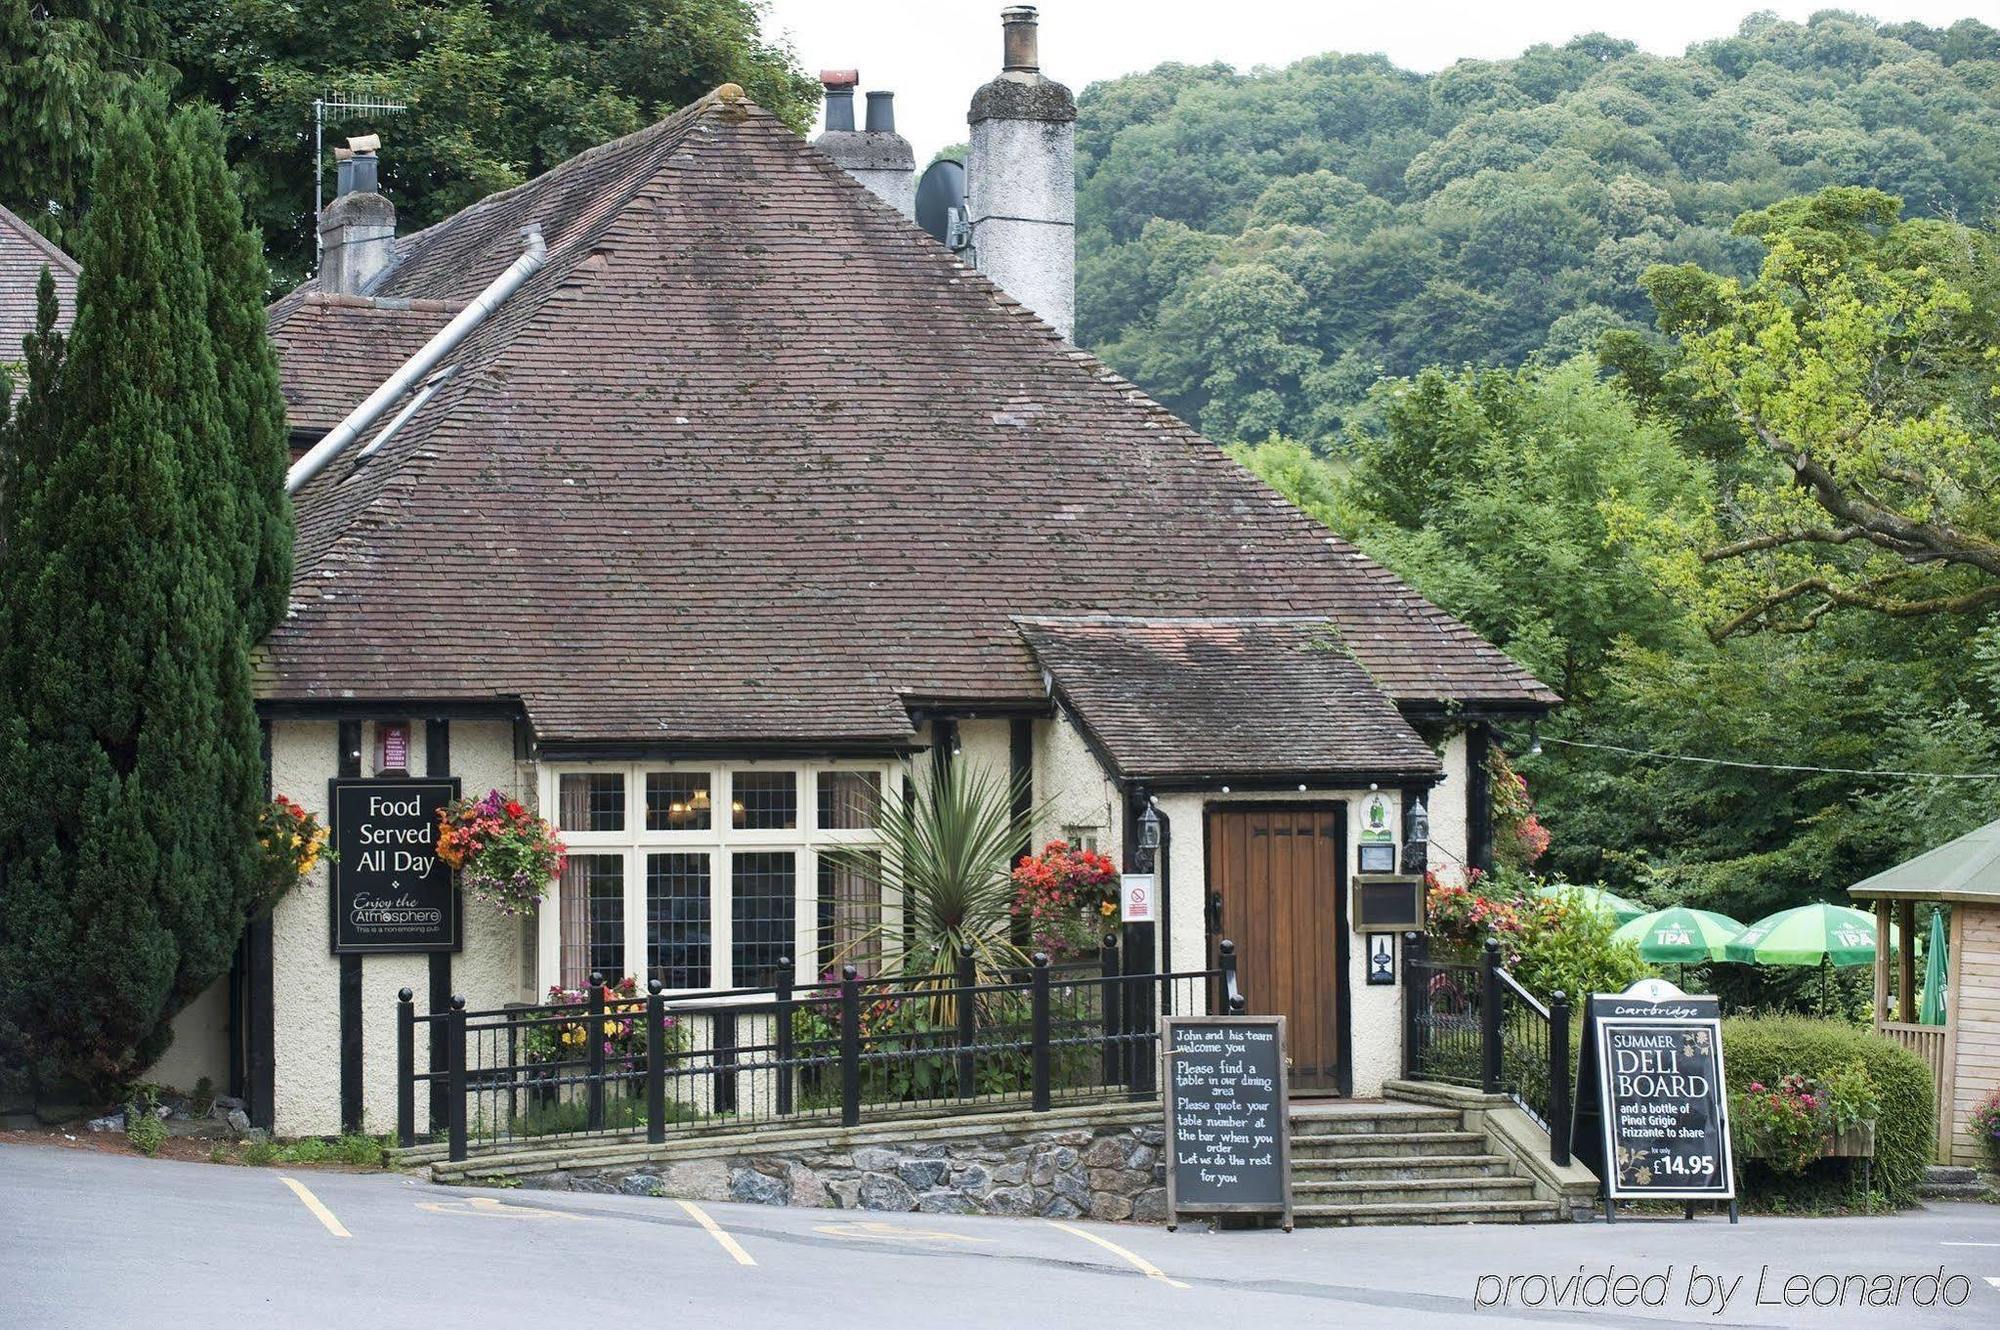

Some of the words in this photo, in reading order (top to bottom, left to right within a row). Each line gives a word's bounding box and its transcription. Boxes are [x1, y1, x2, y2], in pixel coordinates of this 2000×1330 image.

[370, 794, 420, 816] Food
[360, 822, 431, 844] Served
[356, 850, 385, 871] All
[394, 851, 434, 879] Day
[353, 891, 392, 913] Enjoy
[395, 893, 418, 907] the
[356, 911, 439, 923] Atmosphere
[1656, 931, 1691, 945] IPA
[1176, 1030, 1202, 1040] John
[1205, 1030, 1223, 1040] and
[1229, 1030, 1244, 1040] his
[1245, 1030, 1272, 1041] team
[1614, 1035, 1676, 1048] SUMMER
[1177, 1042, 1222, 1053] welcome
[1225, 1044, 1246, 1056] you
[1177, 1061, 1214, 1074] Please
[1219, 1060, 1243, 1073] find
[1249, 1065, 1256, 1073] a
[1616, 1050, 1679, 1074] DELI
[1176, 1075, 1204, 1086] table
[1209, 1077, 1218, 1085] in
[1241, 1074, 1272, 1091] dining
[1618, 1075, 1709, 1097] BOARD
[1178, 1097, 1210, 1110] Please
[1214, 1100, 1242, 1115] quote
[1247, 1103, 1270, 1115] your
[1620, 1103, 1638, 1113] and
[1641, 1105, 1647, 1113] a
[1649, 1103, 1678, 1113] bottle
[1680, 1103, 1690, 1113] of
[1177, 1114, 1202, 1126] table
[1206, 1116, 1248, 1126] number
[1255, 1118, 1266, 1128] at
[1622, 1115, 1646, 1125] Pinot
[1648, 1115, 1676, 1128] Grigio
[1177, 1129, 1196, 1140] the
[1198, 1129, 1215, 1141] bar
[1220, 1131, 1249, 1143] when
[1253, 1135, 1273, 1148] you
[1622, 1128, 1664, 1137] Frizzante
[1667, 1128, 1676, 1137] to
[1679, 1127, 1704, 1138] share
[1207, 1142, 1232, 1152] order
[1179, 1153, 1198, 1164] Let
[1214, 1154, 1225, 1165] do
[1229, 1155, 1245, 1165] the
[1249, 1154, 1272, 1165] rest
[1654, 1156, 1714, 1175] £14.95
[1200, 1168, 1215, 1181] for
[1217, 1174, 1237, 1187] you
